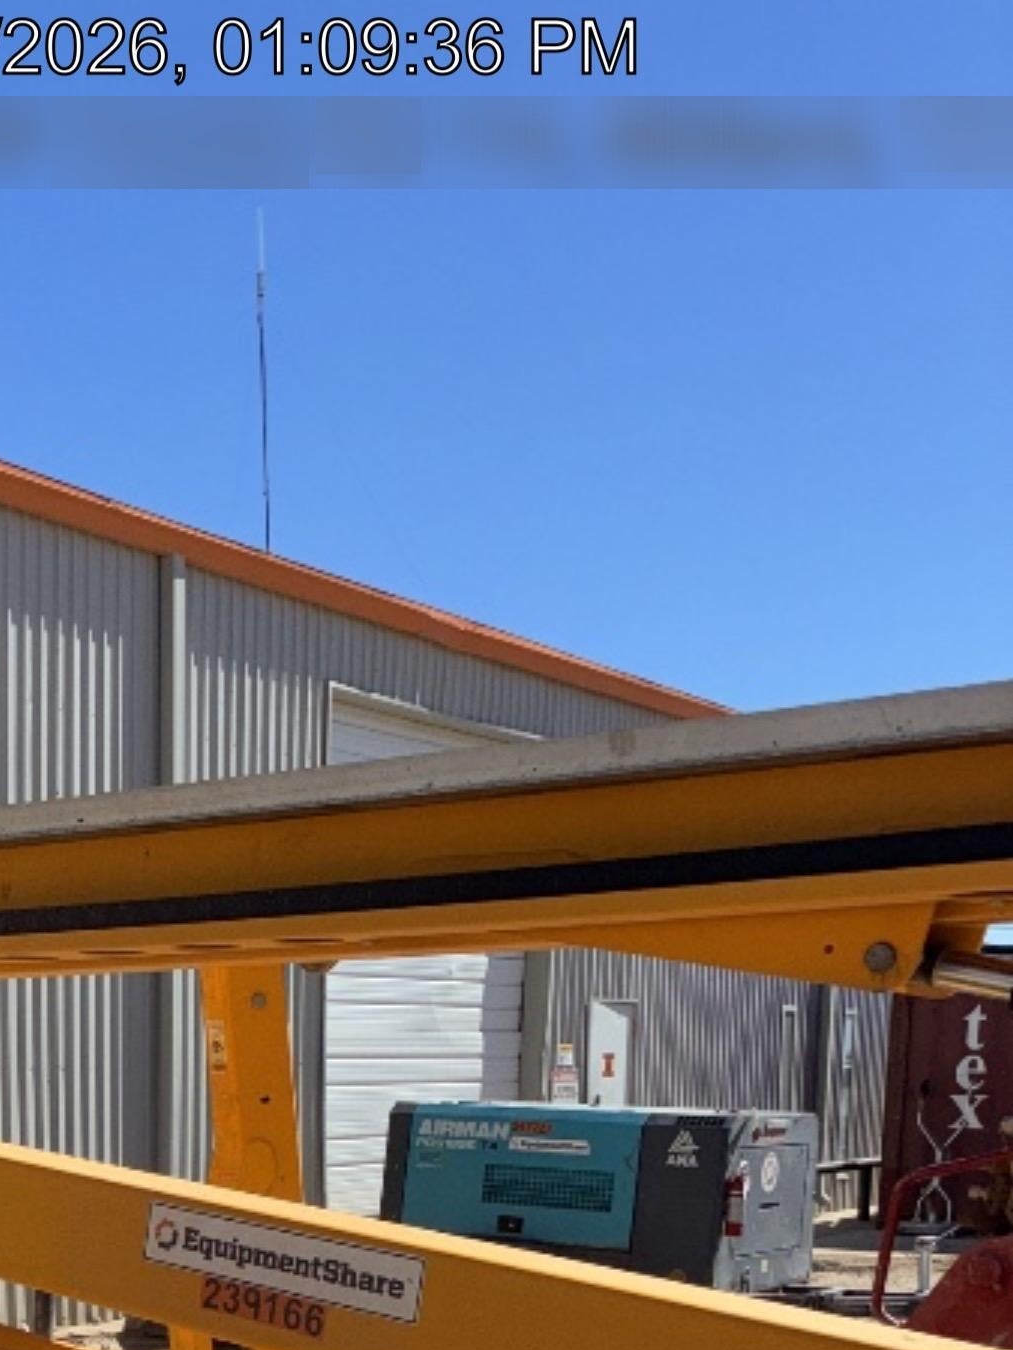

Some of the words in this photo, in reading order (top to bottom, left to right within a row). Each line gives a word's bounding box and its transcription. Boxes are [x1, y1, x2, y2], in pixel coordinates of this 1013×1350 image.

[948, 1003, 989, 1129] tex
[418, 1118, 511, 1141] AIRMAN
[182, 1225, 406, 1299] EquipmentShare
[202, 1277, 325, 1338] 239166
